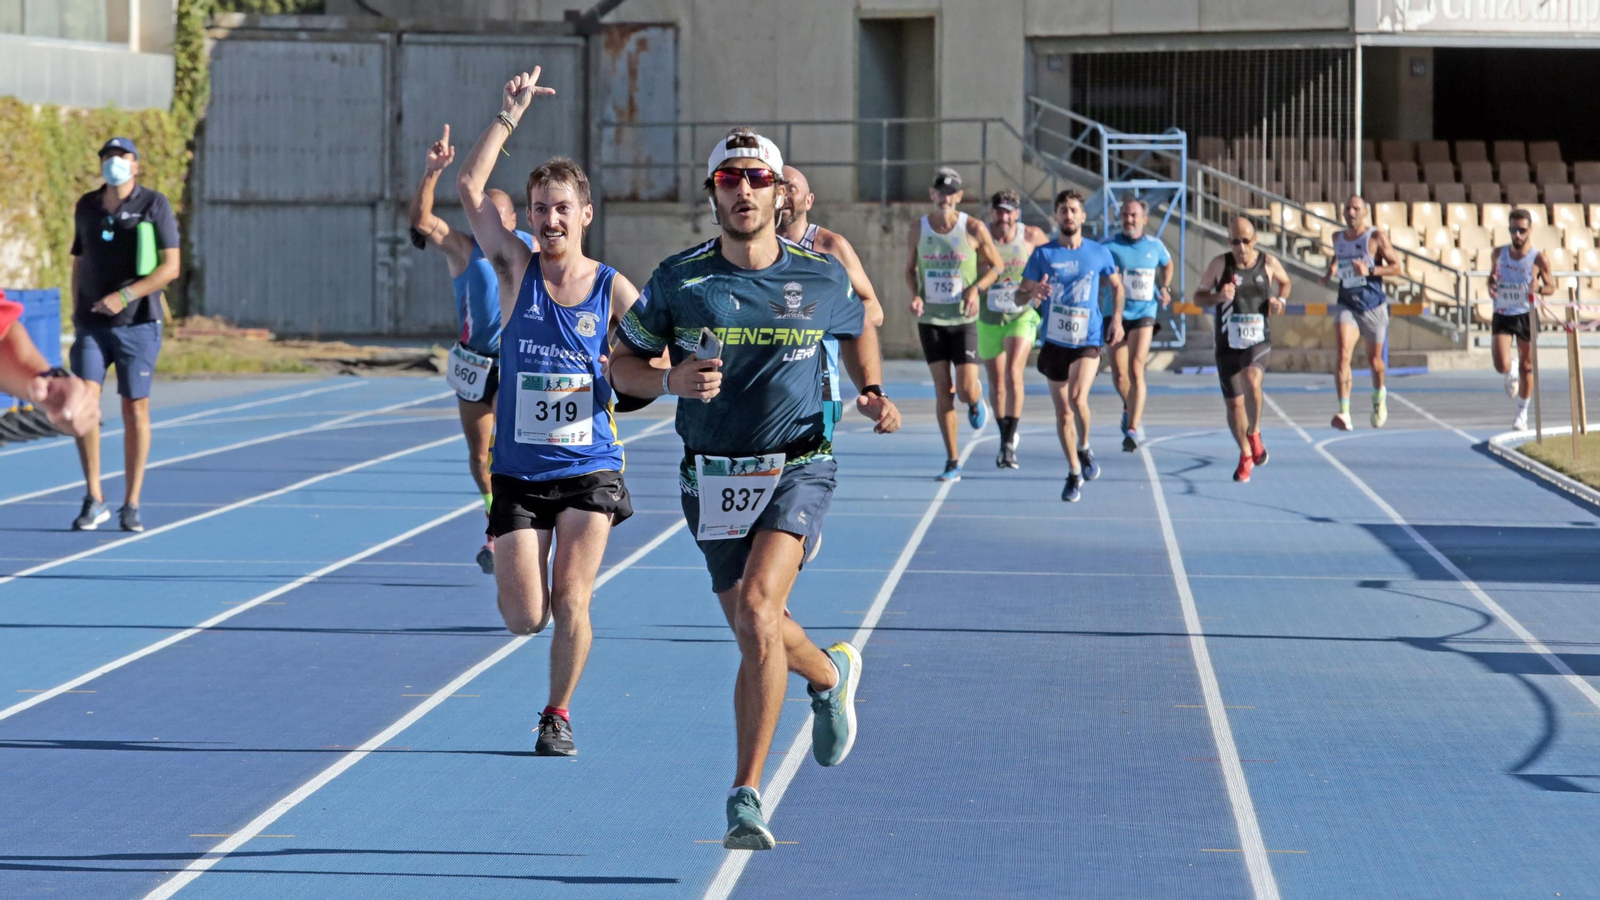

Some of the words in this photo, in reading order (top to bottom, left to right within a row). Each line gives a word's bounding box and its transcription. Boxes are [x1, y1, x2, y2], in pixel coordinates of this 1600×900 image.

[934, 282, 954, 293] 752
[1503, 292, 1520, 301] 610
[1057, 318, 1079, 333] 360
[1238, 328, 1256, 338] 103
[454, 363, 477, 385] 660
[535, 400, 578, 423] 319
[721, 487, 766, 513] 837
